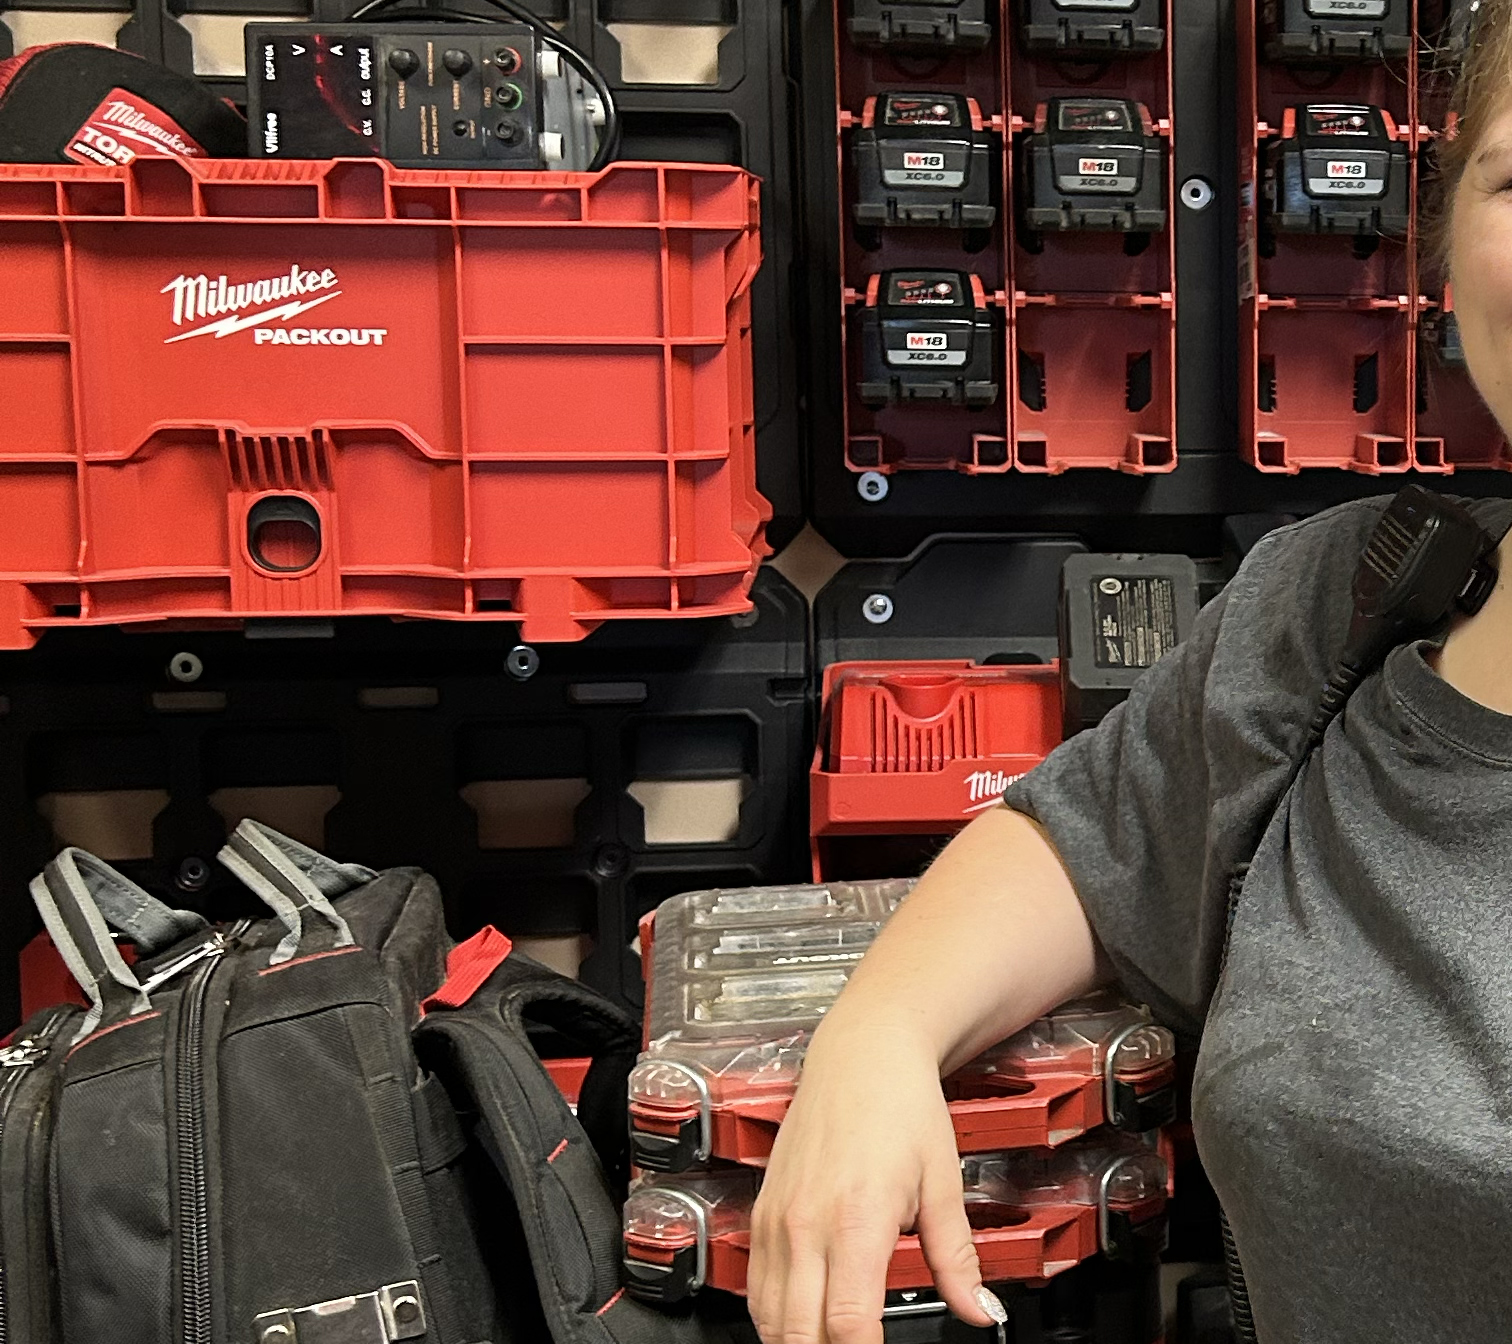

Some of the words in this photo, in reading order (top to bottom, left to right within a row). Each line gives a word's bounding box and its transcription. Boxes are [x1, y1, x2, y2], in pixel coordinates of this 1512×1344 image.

[292, 44, 306, 56] V
[330, 44, 343, 56] A
[103, 101, 198, 156] Milwaukee
[907, 155, 942, 167] M18
[1081, 160, 1116, 173] M18
[1330, 163, 1362, 175] M18
[160, 264, 339, 326] Milwaukee
[254, 327, 388, 347] PACKOUT
[909, 335, 944, 347] M18
